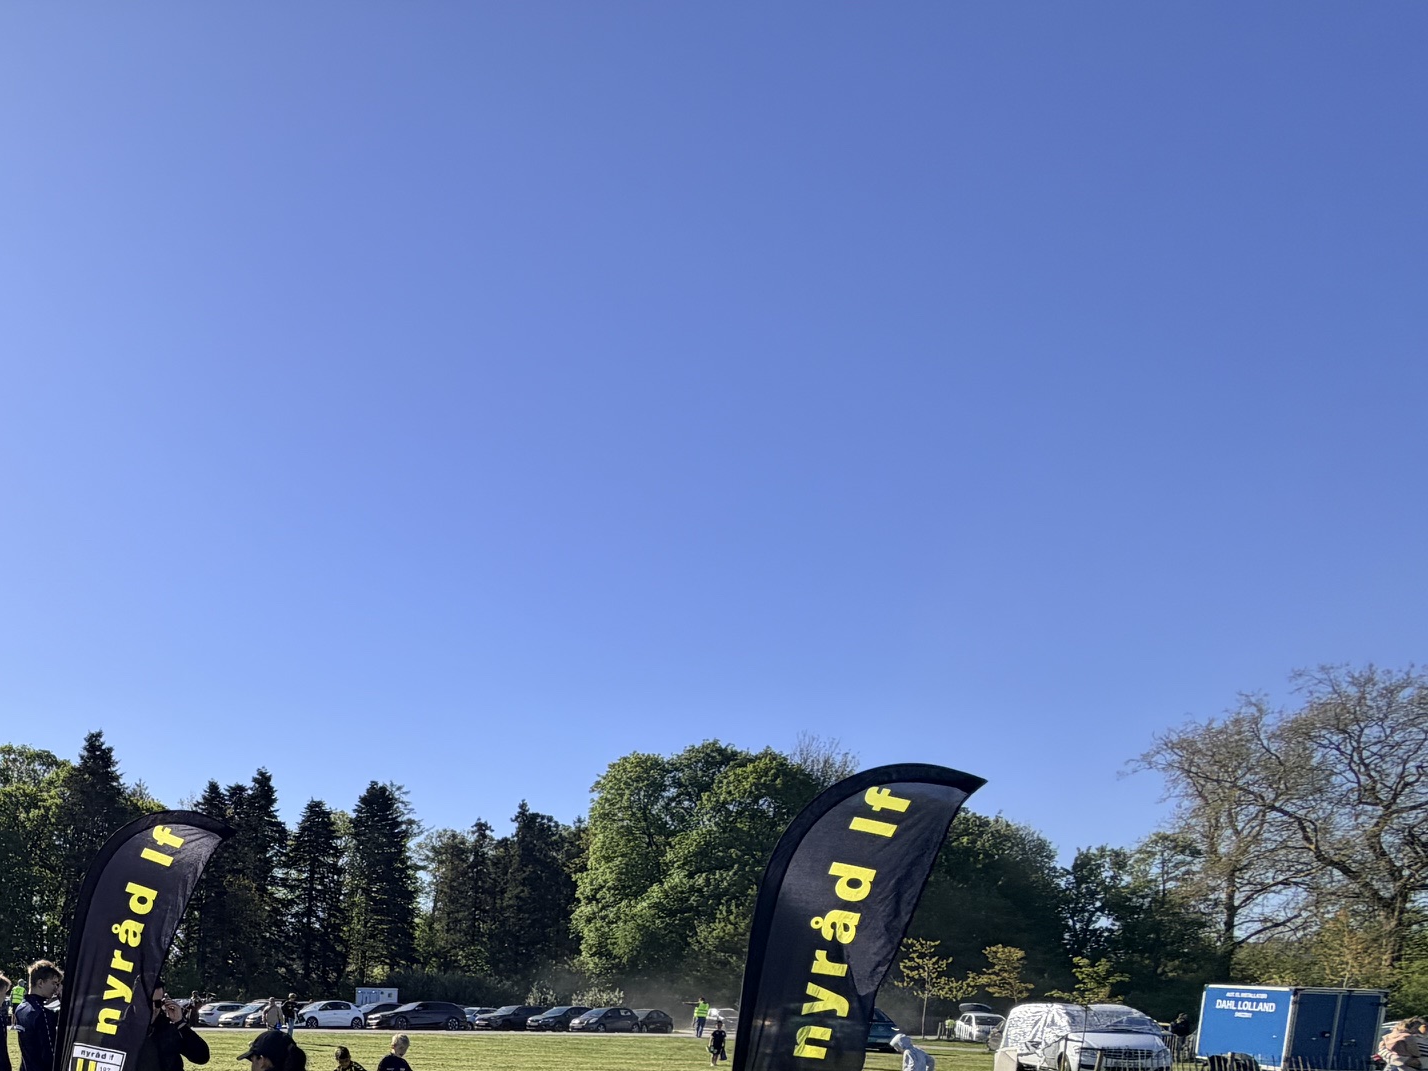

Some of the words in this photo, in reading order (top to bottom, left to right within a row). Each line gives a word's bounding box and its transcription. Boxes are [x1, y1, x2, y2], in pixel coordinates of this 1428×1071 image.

[96, 882, 158, 1036] nyråd
[793, 862, 877, 1060] nyråd
[1216, 999, 1236, 1009] DAHL
[1237, 1001, 1276, 1012] LOLLAND
[80, 1049, 107, 1059] nyråd
